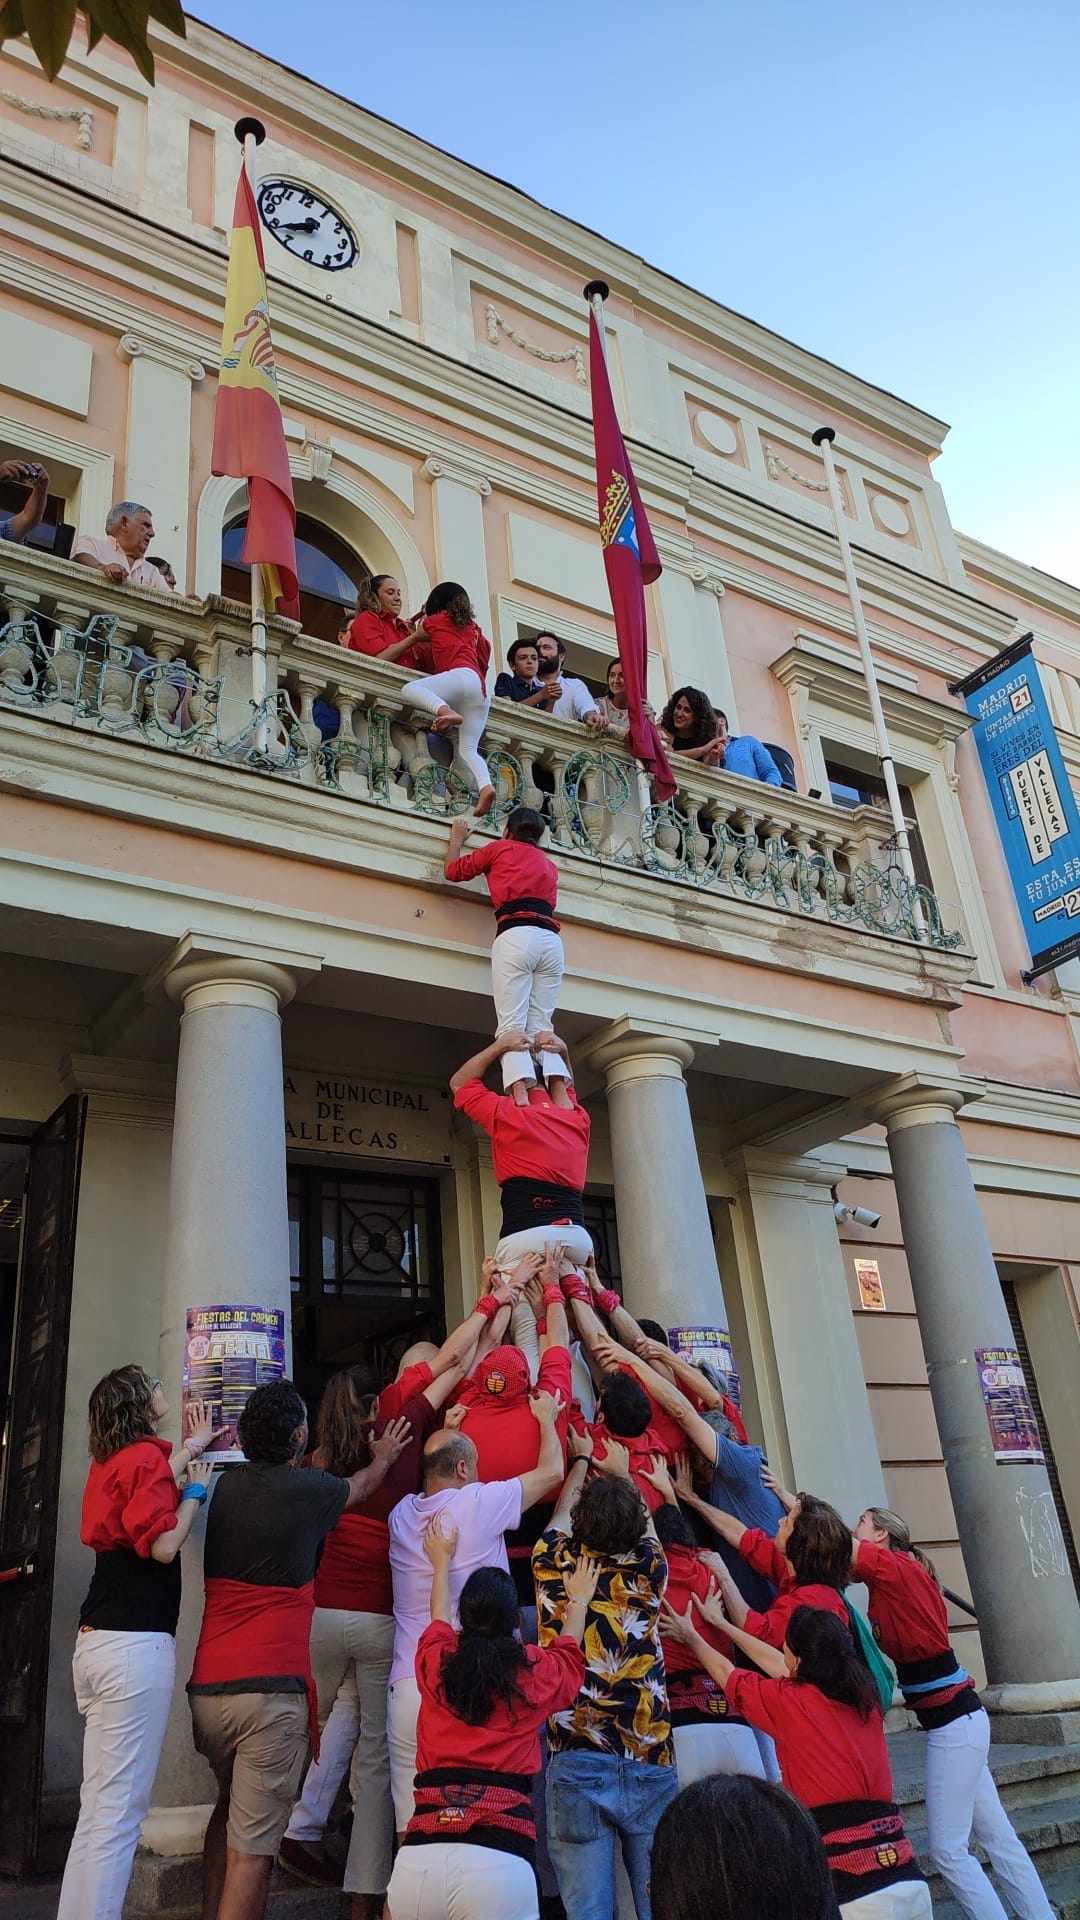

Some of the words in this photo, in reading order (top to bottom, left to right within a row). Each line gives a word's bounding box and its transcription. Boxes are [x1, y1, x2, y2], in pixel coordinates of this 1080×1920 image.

[265, 191, 282, 205] 10
[299, 194, 315, 209] 12
[264, 203, 275, 214] 9
[320, 209, 330, 219] 1
[269, 218, 280, 229] 8
[334, 222, 344, 235] 2
[284, 234, 294, 246] 7
[338, 238, 348, 250] 3
[303, 249, 314, 261] 6
[323, 254, 332, 266] 5
[333, 252, 345, 262] 4
[977, 673, 1028, 713] MADRID
[980, 696, 1009, 720] TIENE
[1014, 691, 1028, 708] 21
[985, 711, 1014, 733] JUNTAS
[999, 704, 1037, 734] DISTRITO
[994, 755, 1021, 774] ERES
[1022, 741, 1045, 758] DEL
[1034, 758, 1061, 833] VALLECAS
[1016, 770, 1037, 826] PUENTE
[1033, 835, 1044, 854] DE
[1025, 869, 1060, 896] ESTA
[1028, 889, 1043, 904] TU
[316, 1080, 430, 1112] MUNICIPAL
[318, 1102, 344, 1121] DE
[285, 1122, 399, 1150] ALLECAS
[197, 1311, 232, 1324] FIESTAS
[234, 1311, 248, 1322] DEL
[251, 1311, 279, 1326] CARMEN
